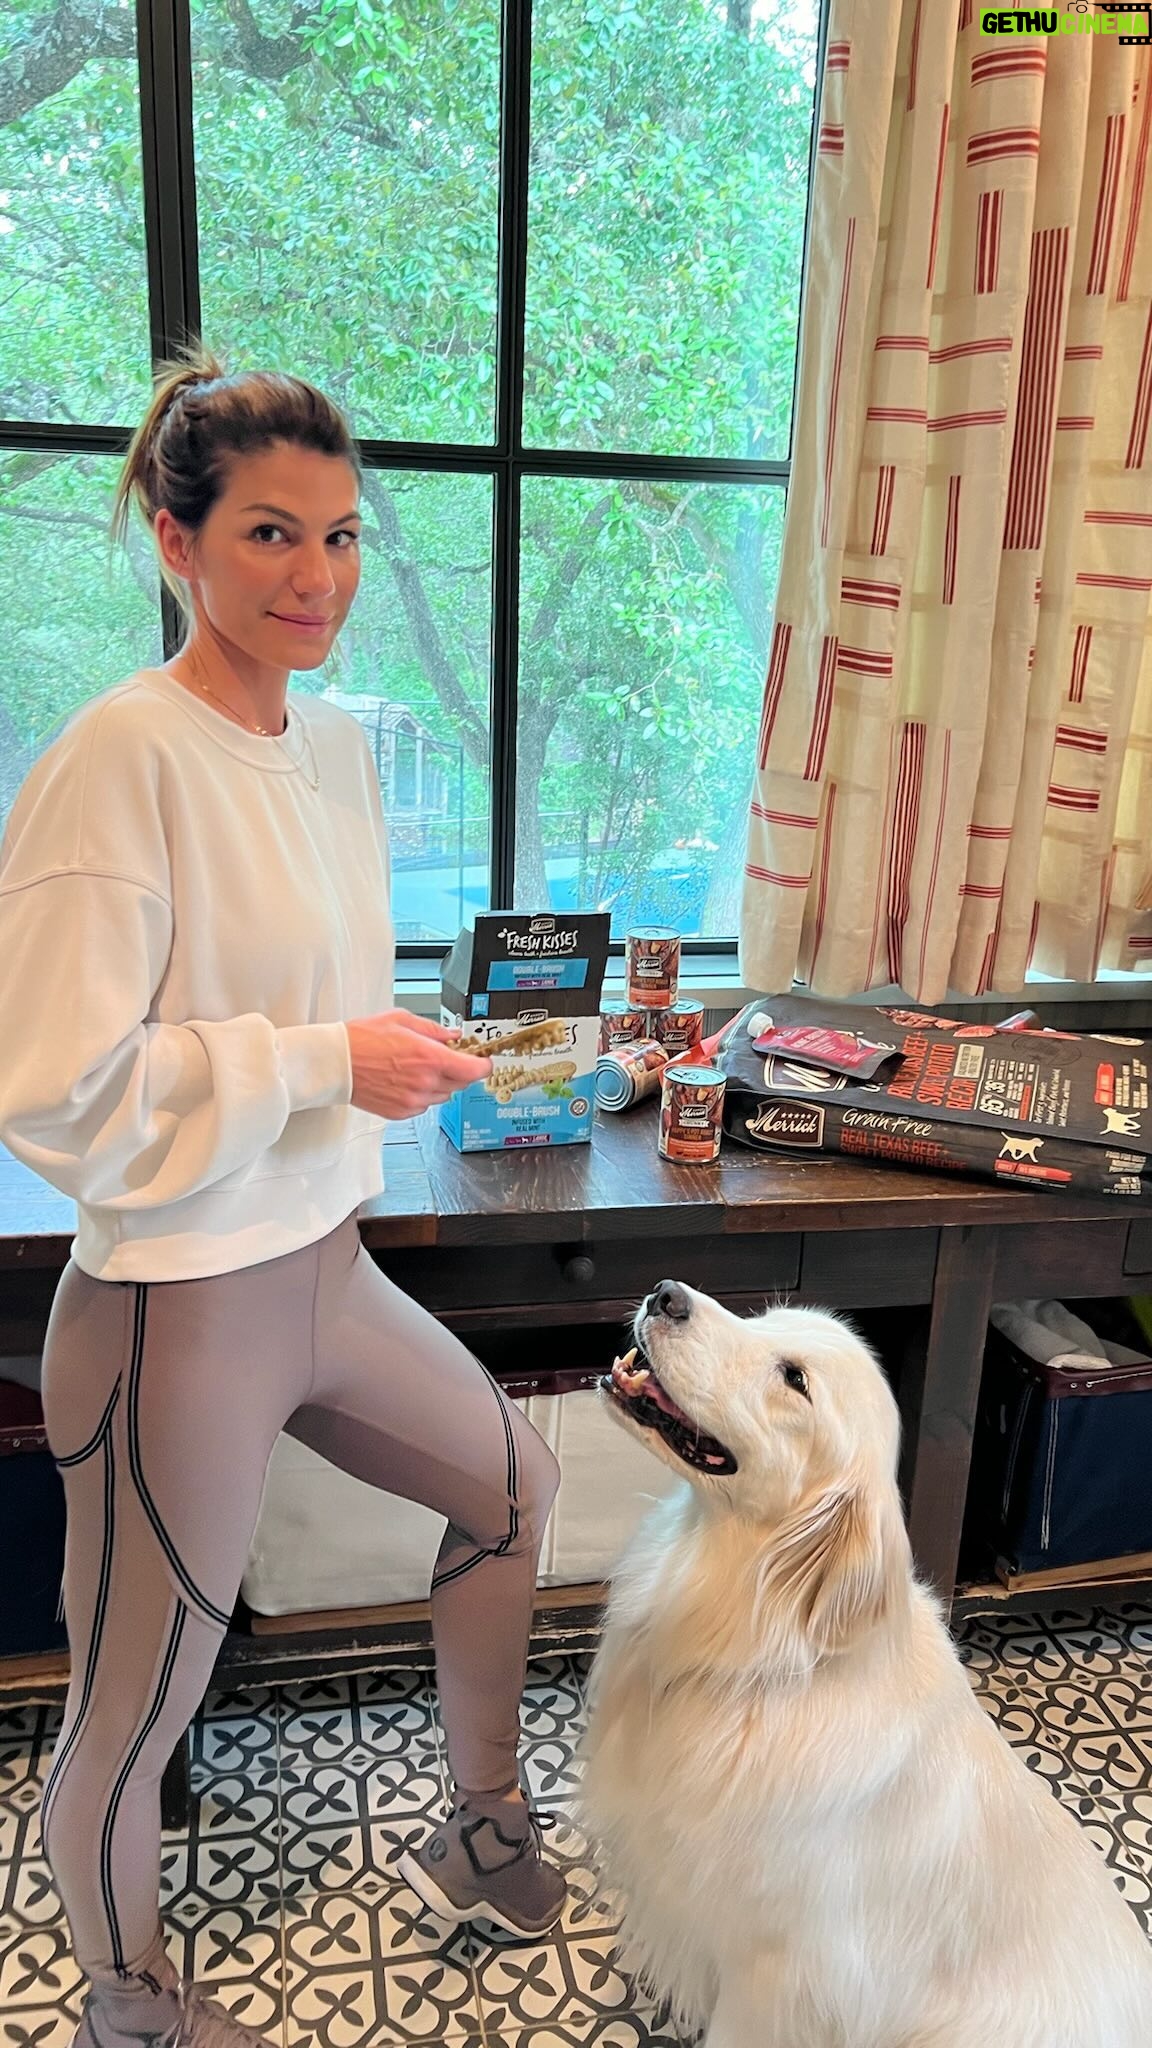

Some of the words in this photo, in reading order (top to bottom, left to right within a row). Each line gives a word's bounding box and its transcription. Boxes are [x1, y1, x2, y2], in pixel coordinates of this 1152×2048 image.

[507, 931, 541, 951] FRESH
[543, 930, 579, 951] KISSES
[745, 1107, 817, 1134] Merrick
[842, 1108, 888, 1130] Grain
[891, 1116, 933, 1136] Free
[841, 1128, 868, 1146] REAL
[872, 1133, 909, 1152] TEXAS
